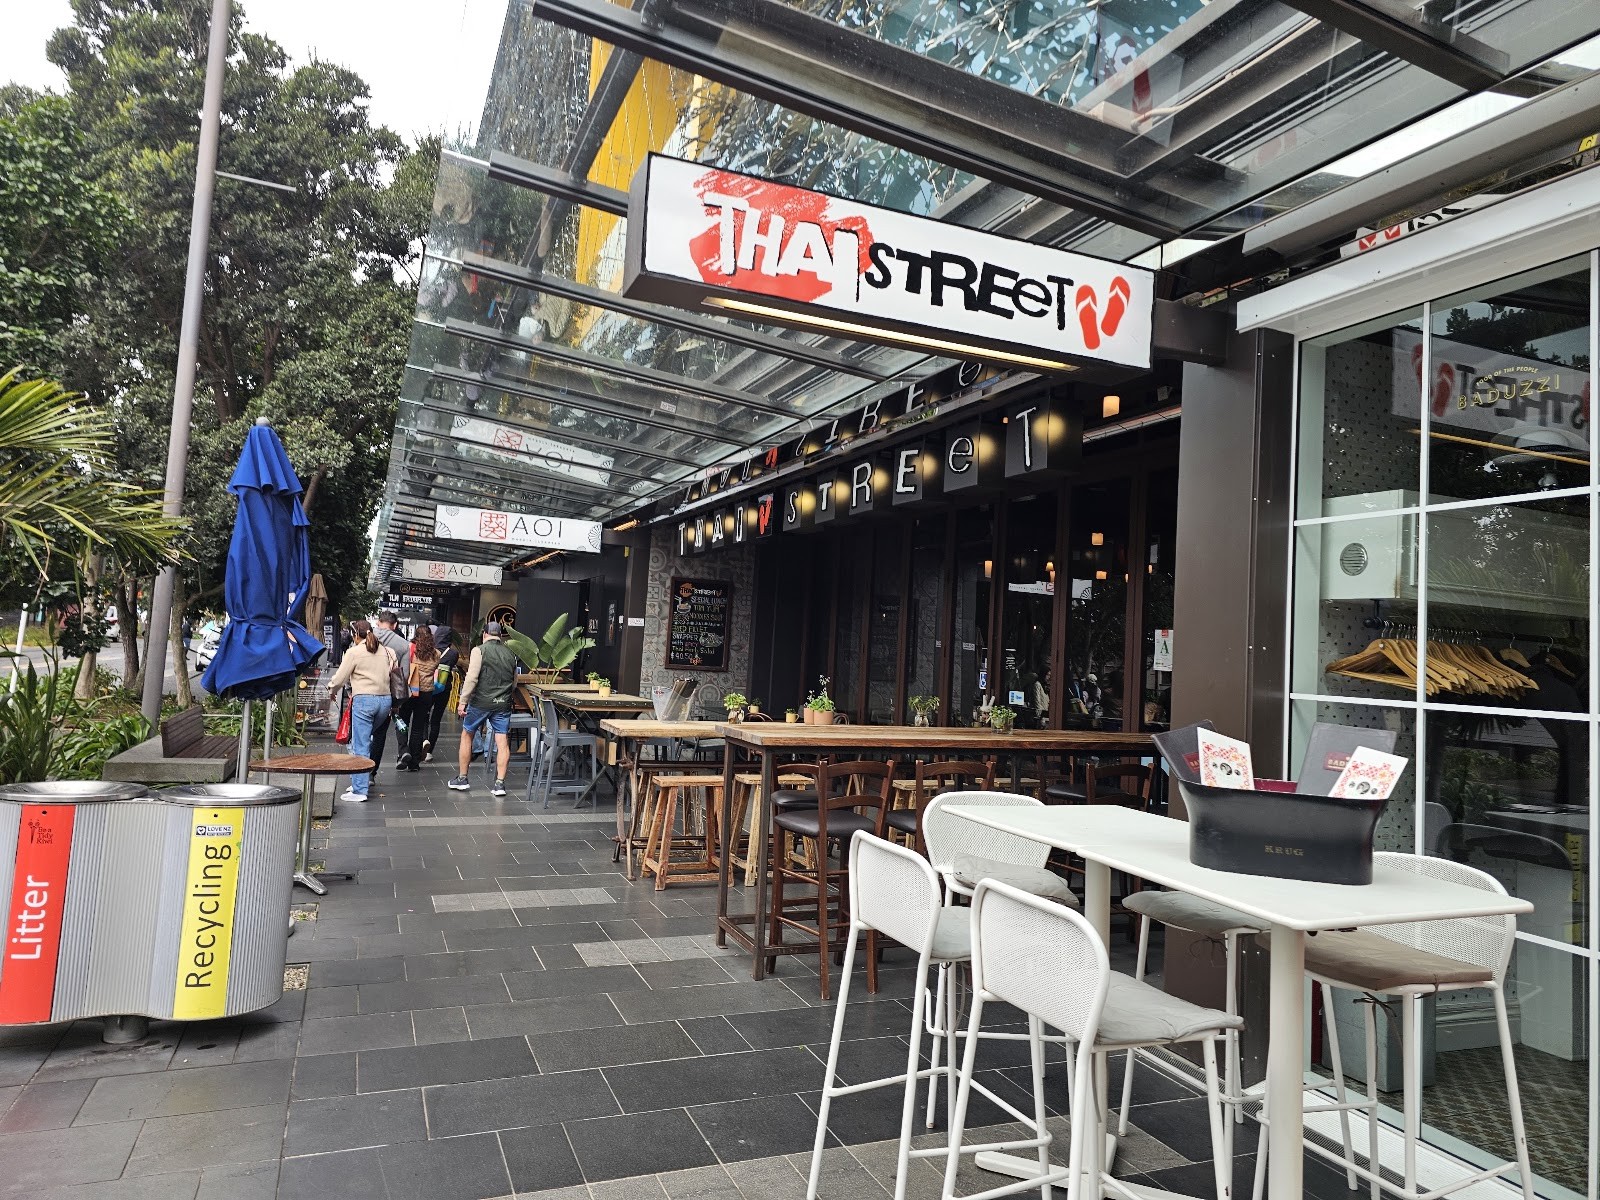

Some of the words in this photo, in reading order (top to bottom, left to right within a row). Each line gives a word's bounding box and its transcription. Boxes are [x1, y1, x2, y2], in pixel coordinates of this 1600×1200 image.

[704, 192, 859, 302] THAI
[1493, 369, 1502, 377] OF
[1503, 366, 1515, 374] THE
[1516, 366, 1540, 374] PEOPLE
[1457, 374, 1560, 410] BADUZZI
[511, 516, 563, 538] AOI
[447, 564, 479, 578] AOI
[1264, 845, 1304, 856] KRUG
[11, 875, 49, 960] Litter
[184, 844, 232, 988] Recycling
